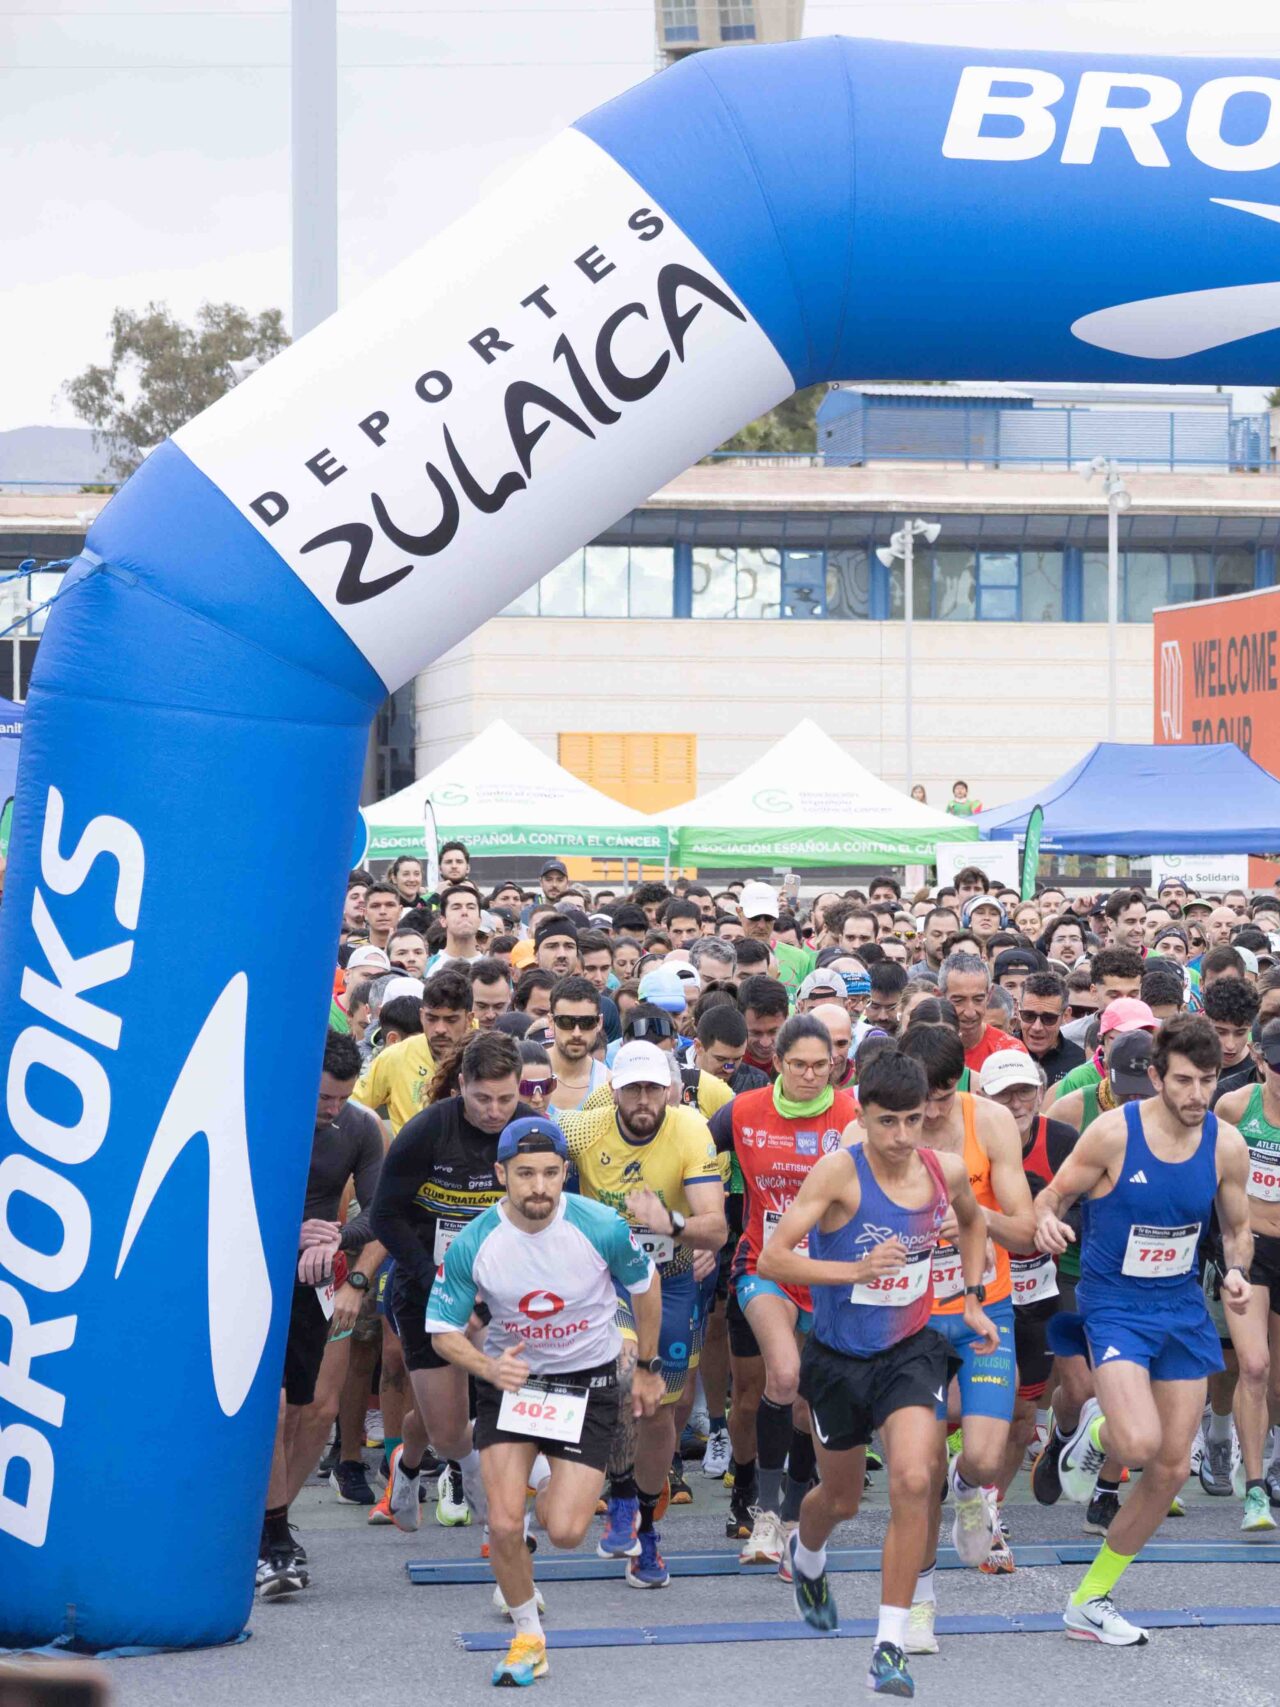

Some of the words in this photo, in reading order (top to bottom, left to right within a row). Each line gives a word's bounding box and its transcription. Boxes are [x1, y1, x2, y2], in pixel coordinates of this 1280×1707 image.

[249, 207, 665, 528] DEPORTES
[300, 263, 747, 605] ZULAICA
[1193, 631, 1278, 698] WELCOME
[528, 832, 583, 847] CONTRA
[587, 835, 603, 847] EL
[604, 832, 662, 849] CÁNCER
[692, 843, 770, 855] ASOCIACIÓN
[773, 839, 842, 854] ESPAÑOLA
[843, 840, 895, 853] CONTRA
[898, 844, 912, 853] EL
[1196, 873, 1240, 882] Solidaria
[423, 1186, 445, 1201] CLUB
[446, 1192, 493, 1205] TRIATLÓN
[1139, 1248, 1177, 1262] 729
[867, 1276, 909, 1291] 384
[512, 1401, 557, 1420] 402
